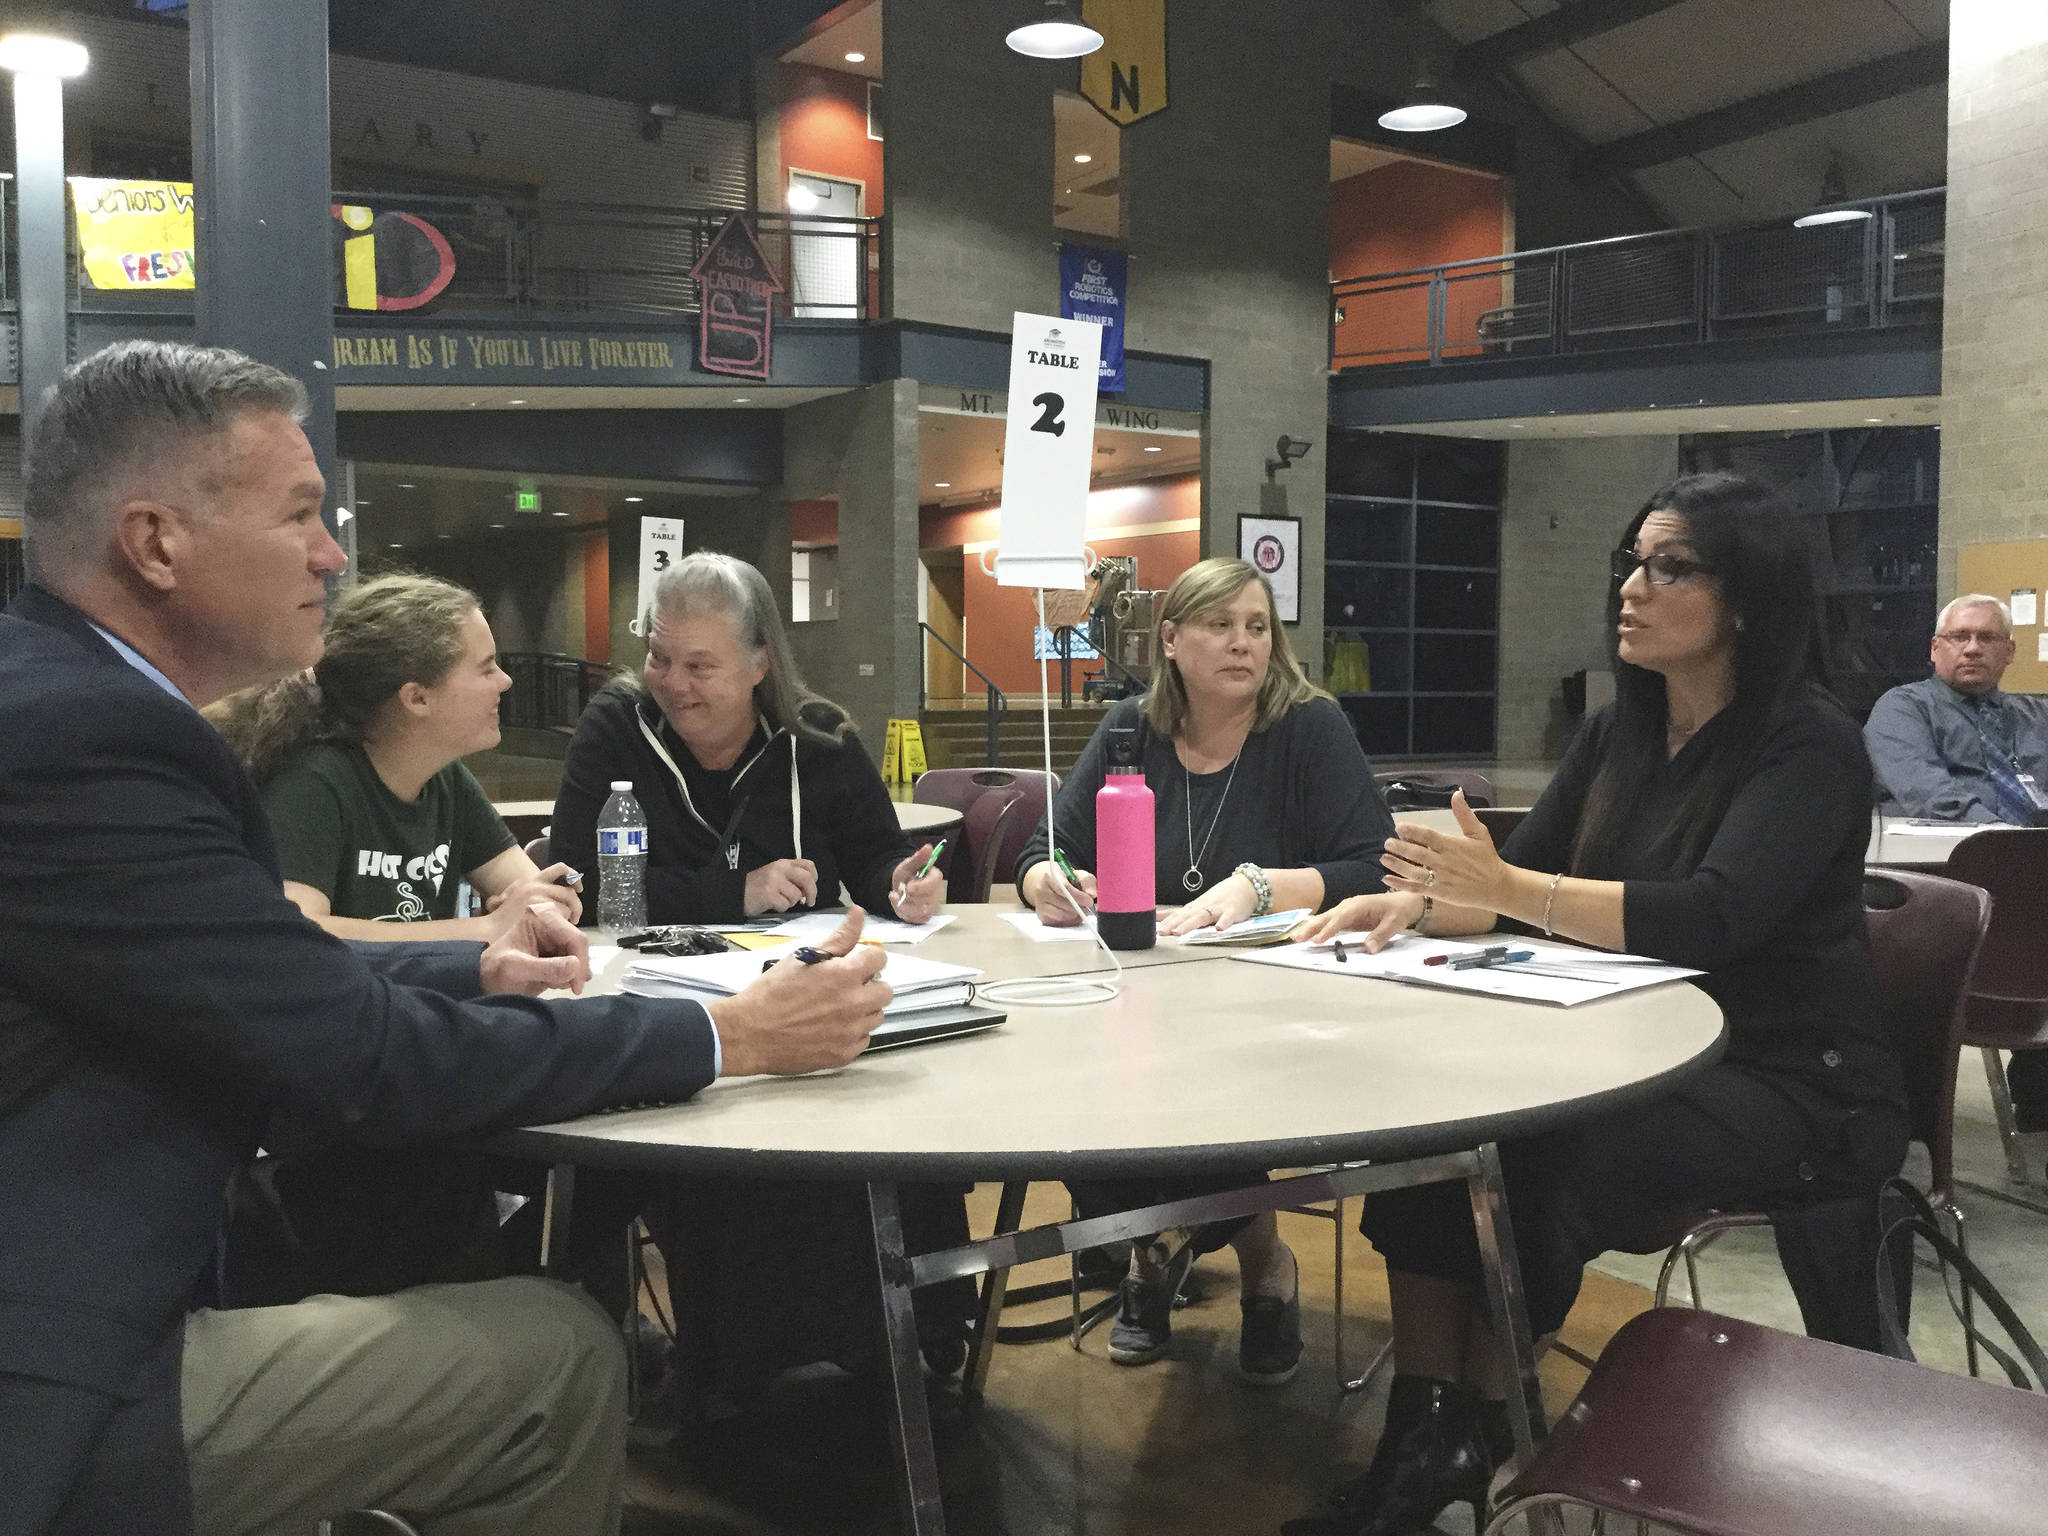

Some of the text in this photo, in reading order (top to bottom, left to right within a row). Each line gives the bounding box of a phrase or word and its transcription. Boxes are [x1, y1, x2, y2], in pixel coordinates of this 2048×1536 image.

[1111, 61, 1139, 114] N
[1073, 311, 1114, 328] WINNER
[588, 337, 674, 371] FOREVER
[1027, 350, 1080, 370] TABLE
[1030, 392, 1066, 438] 2
[1106, 408, 1160, 431] WING
[651, 532, 677, 541] TABLE
[653, 550, 671, 572] 3
